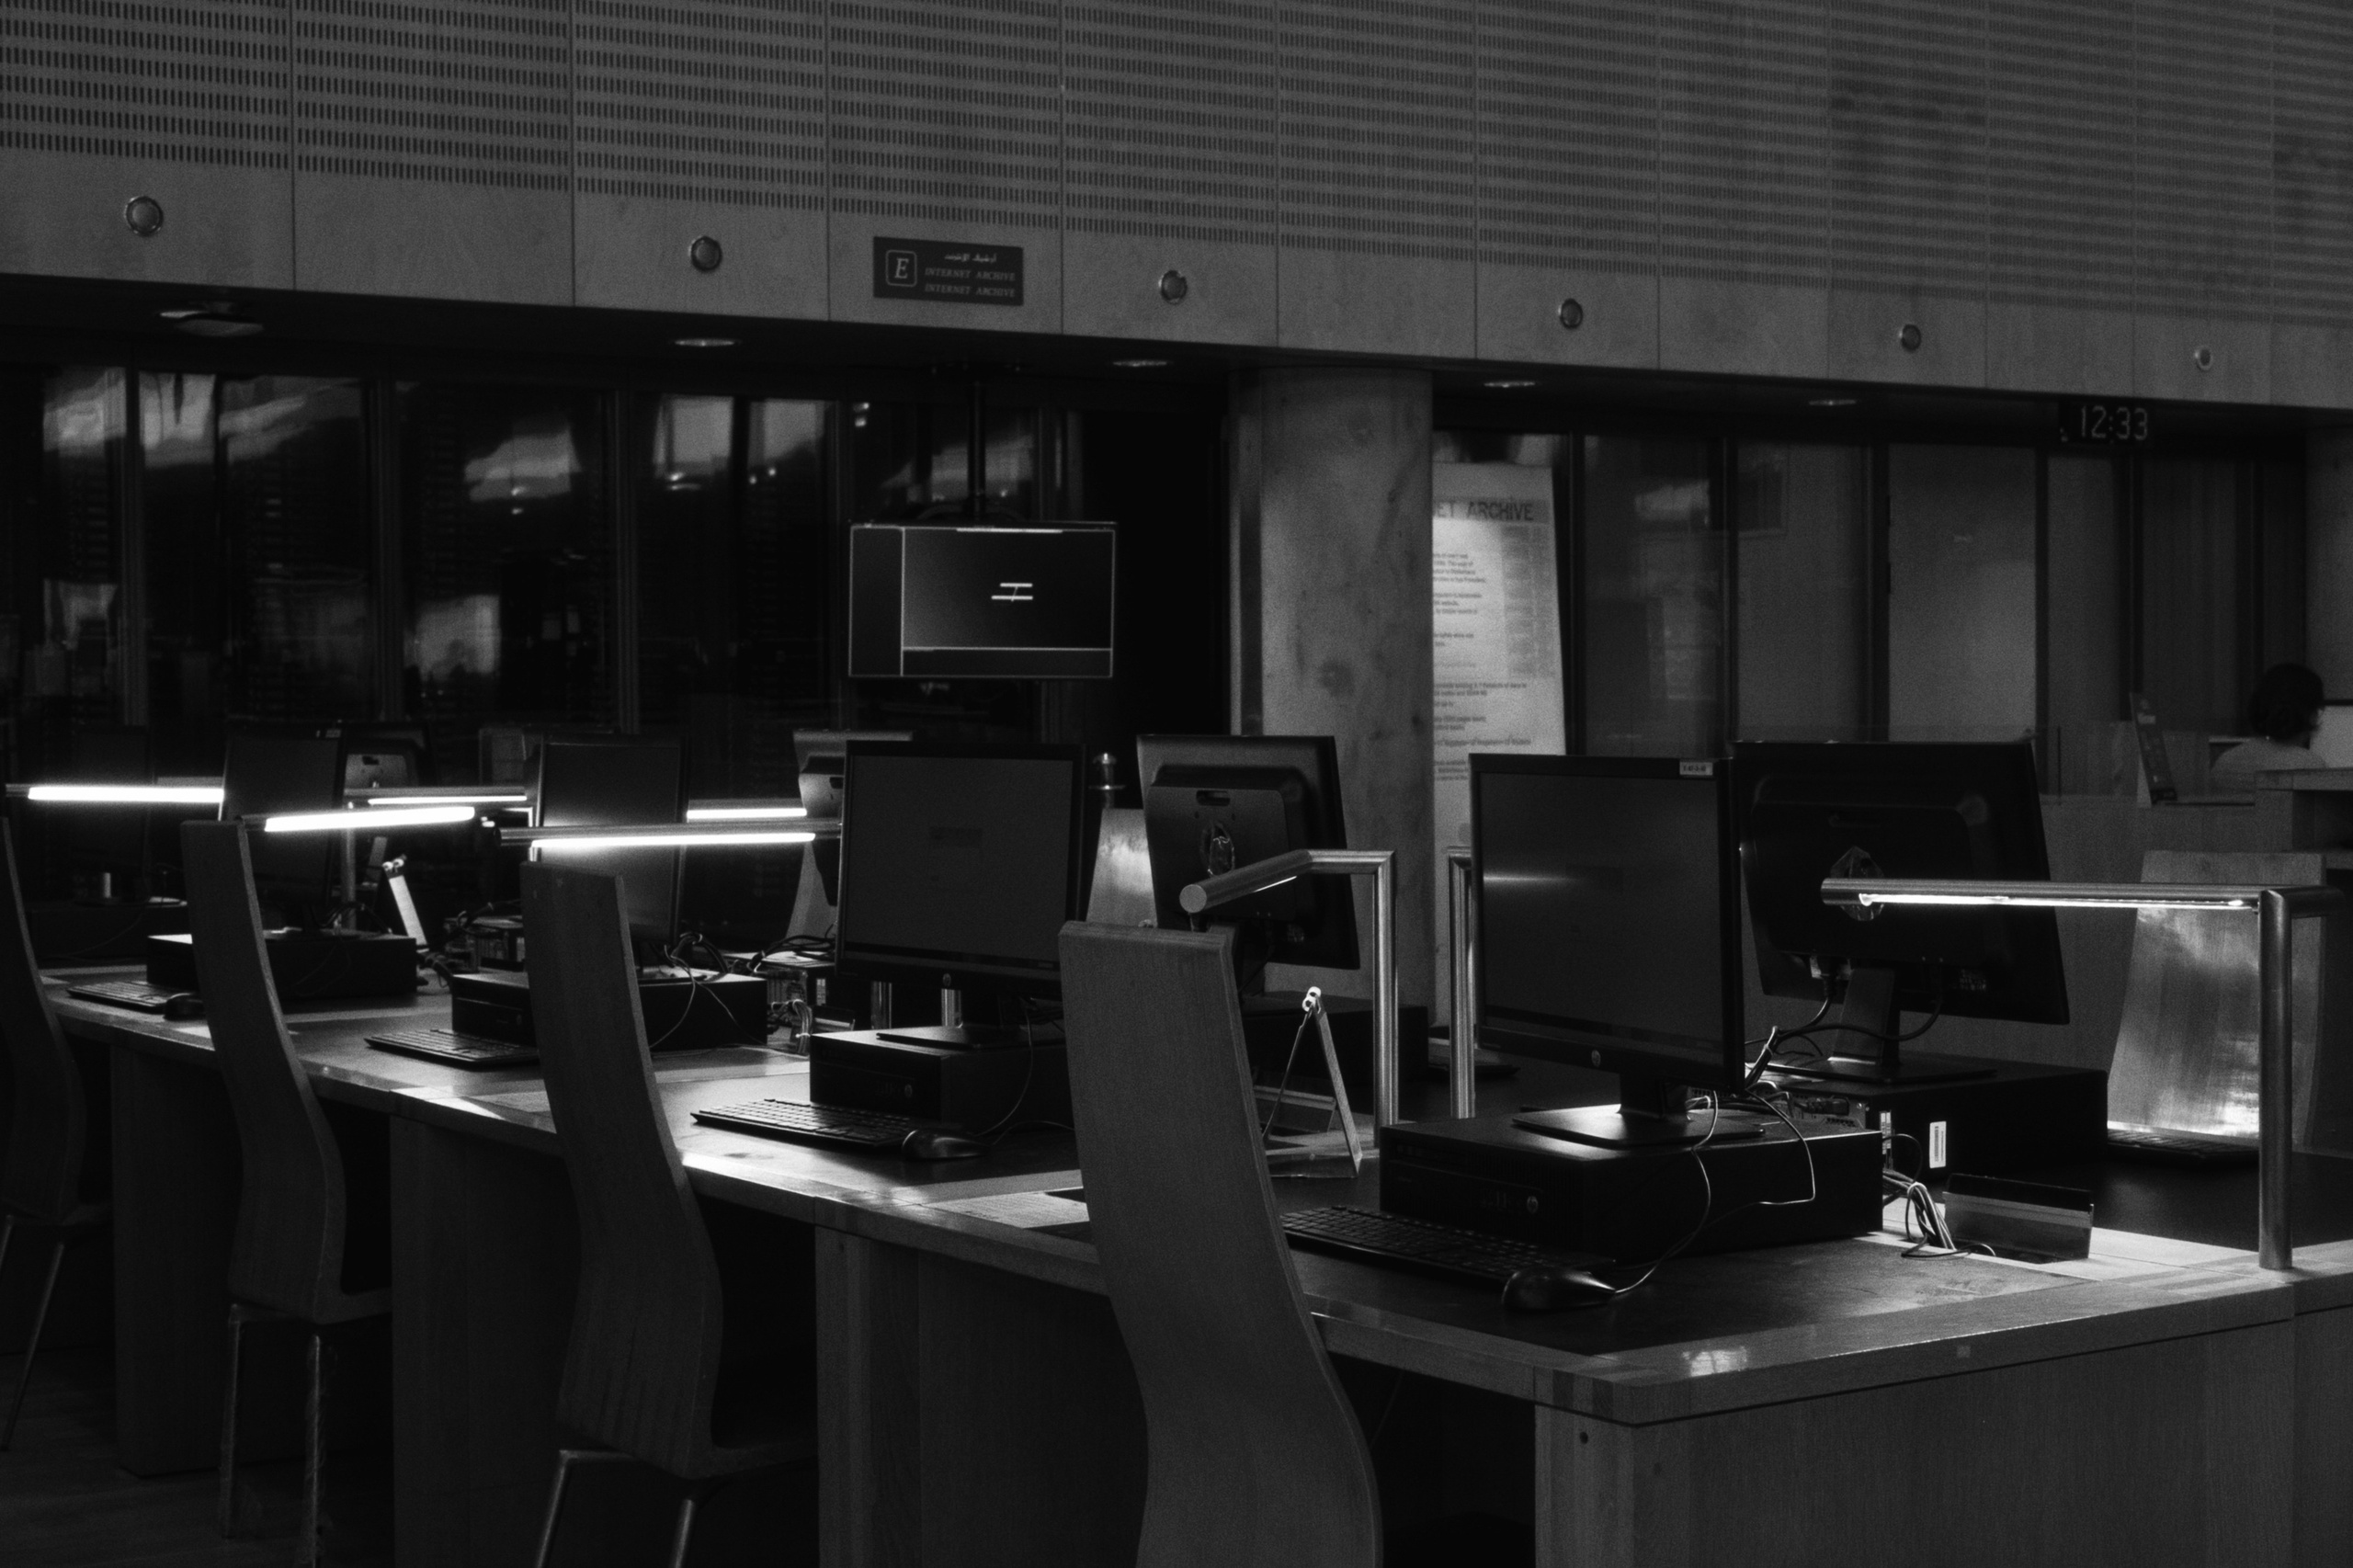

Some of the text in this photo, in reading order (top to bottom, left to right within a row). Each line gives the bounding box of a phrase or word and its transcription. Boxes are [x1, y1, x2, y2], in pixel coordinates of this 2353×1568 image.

[894, 257, 909, 279] E
[925, 267, 1016, 281] INTERNET ARCHIVE
[925, 283, 1016, 298] INTERNET ARCHIVE
[2081, 404, 2148, 441] 12:33
[1433, 500, 1534, 521] ET ARCHIVE
